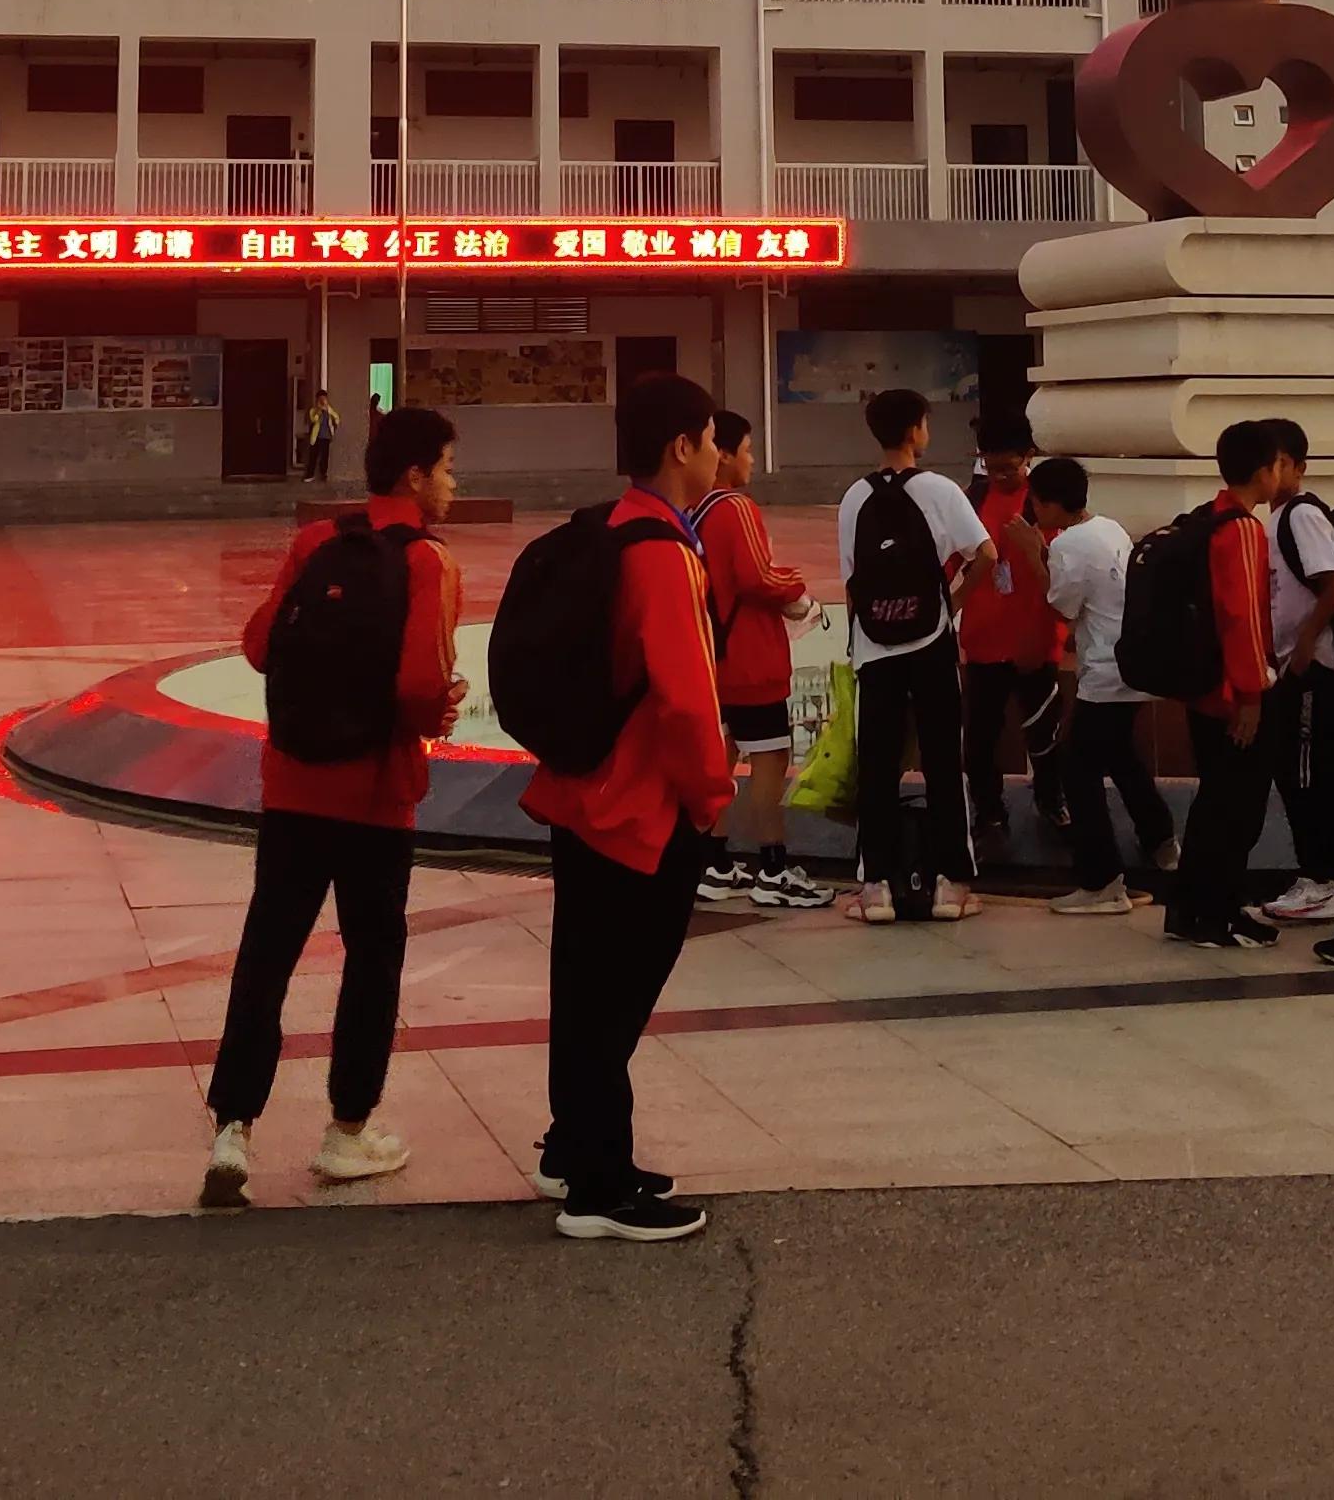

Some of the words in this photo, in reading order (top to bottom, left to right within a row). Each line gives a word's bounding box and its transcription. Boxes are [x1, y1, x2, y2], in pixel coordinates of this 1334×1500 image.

[59, 230, 117, 259] 文明
[133, 230, 194, 259] 和谐
[241, 230, 296, 259] 自由
[312, 230, 369, 259] 平等
[384, 230, 440, 259] 公正
[454, 230, 509, 259] 法治
[553, 230, 607, 259] 爱国
[622, 230, 676, 259] 敬业
[689, 230, 742, 259] 诚信
[756, 230, 810, 259] 友善
